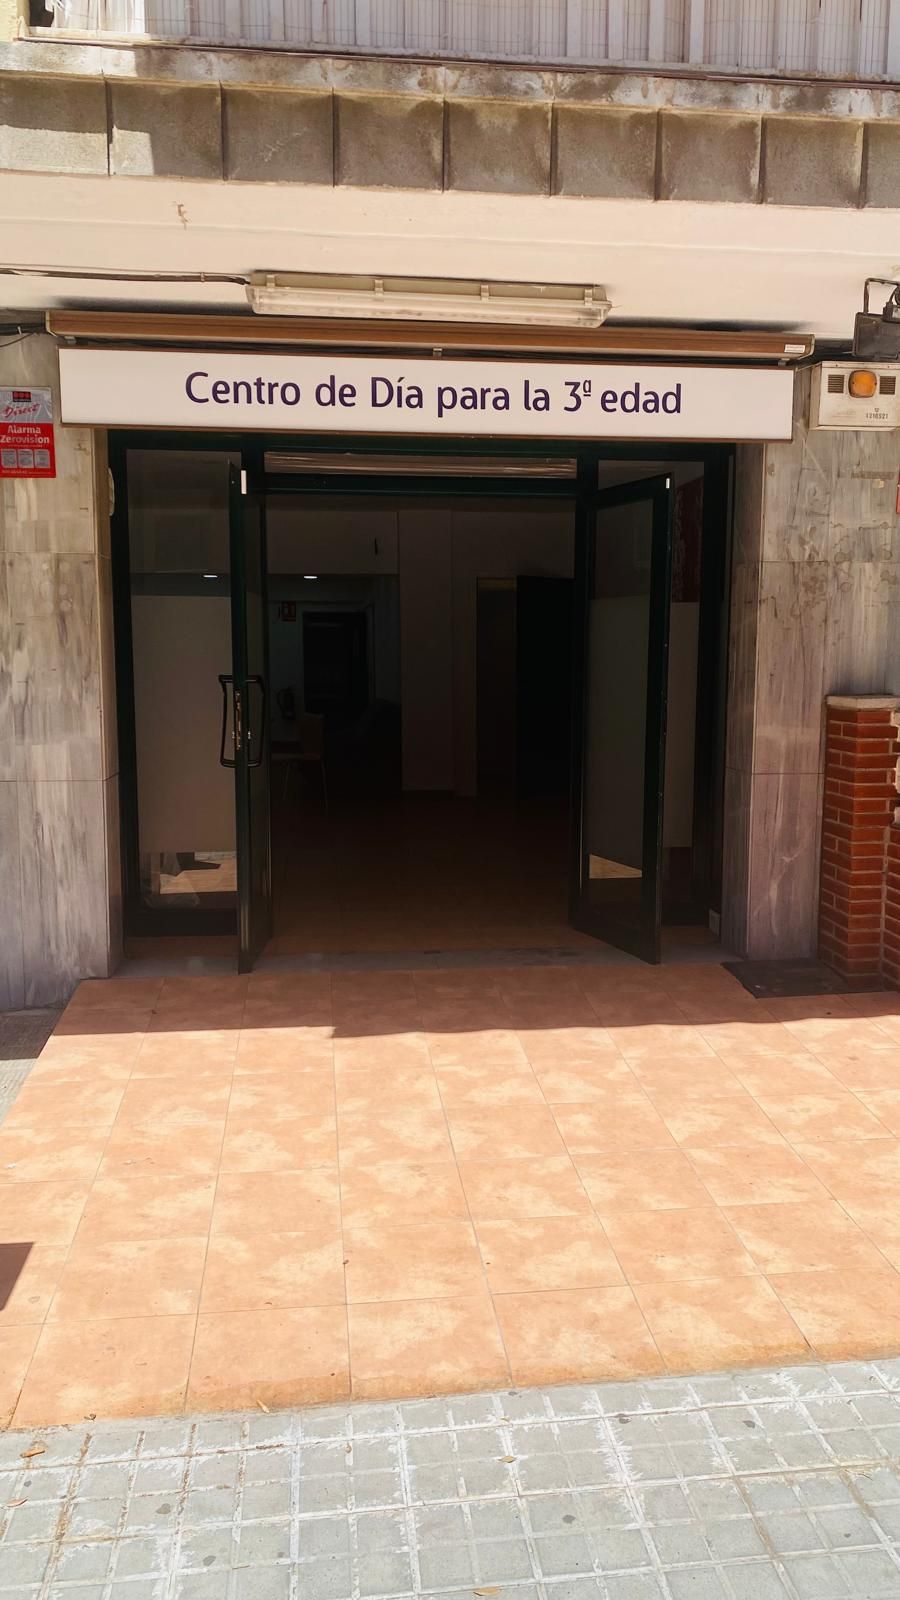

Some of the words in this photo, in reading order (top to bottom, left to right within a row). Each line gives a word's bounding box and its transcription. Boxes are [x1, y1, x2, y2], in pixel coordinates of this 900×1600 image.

[185, 371, 301, 407] Centro
[315, 374, 357, 408] de
[371, 376, 424, 409] Día
[437, 386, 510, 419] para
[523, 379, 550, 412] la
[563, 379, 592, 413] 3ª
[600, 382, 682, 414] edad
[8, 425, 41, 434] Alarma
